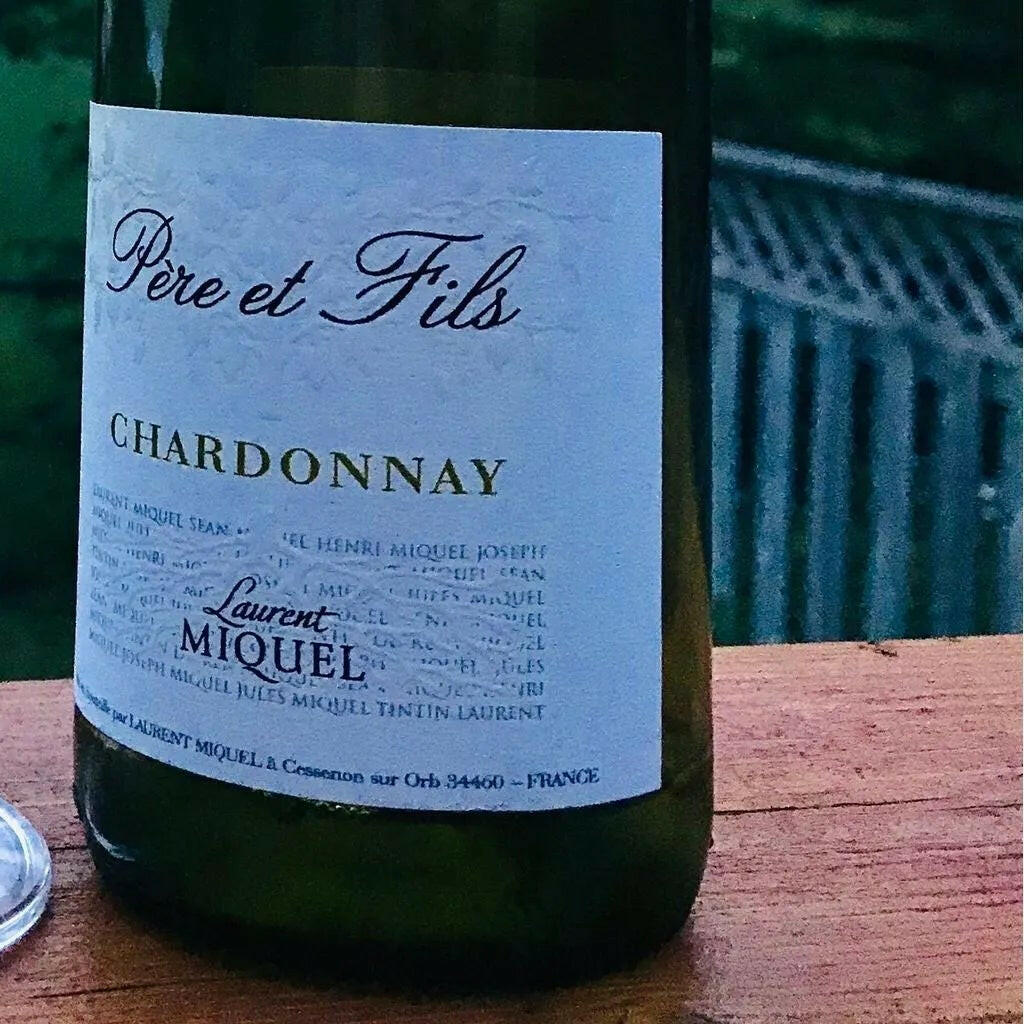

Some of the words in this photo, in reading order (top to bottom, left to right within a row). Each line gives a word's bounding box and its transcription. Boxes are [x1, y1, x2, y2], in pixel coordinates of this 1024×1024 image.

[106, 208, 231, 309] Père
[239, 260, 314, 317] et
[319, 230, 528, 331] Fils
[109, 412, 508, 496] CHARDONNAY
[133, 502, 184, 529] MIQUEL
[317, 536, 381, 558] HENRI
[390, 543, 472, 563] MIQUEL
[477, 543, 548, 563] JOSEPH
[202, 576, 341, 633] Laurent
[179, 617, 367, 682] MIQUEL
[170, 667, 232, 694] MIQUEL
[236, 681, 286, 705] JULES
[457, 703, 548, 722] LAURENT
[129, 713, 193, 750] LAURENT
[195, 737, 263, 769] MIQUEL
[282, 758, 364, 784] Cessenon
[370, 775, 399, 787] sur
[404, 772, 441, 788] Orb
[446, 774, 504, 790] 34460
[527, 767, 600, 790] FRANCE
